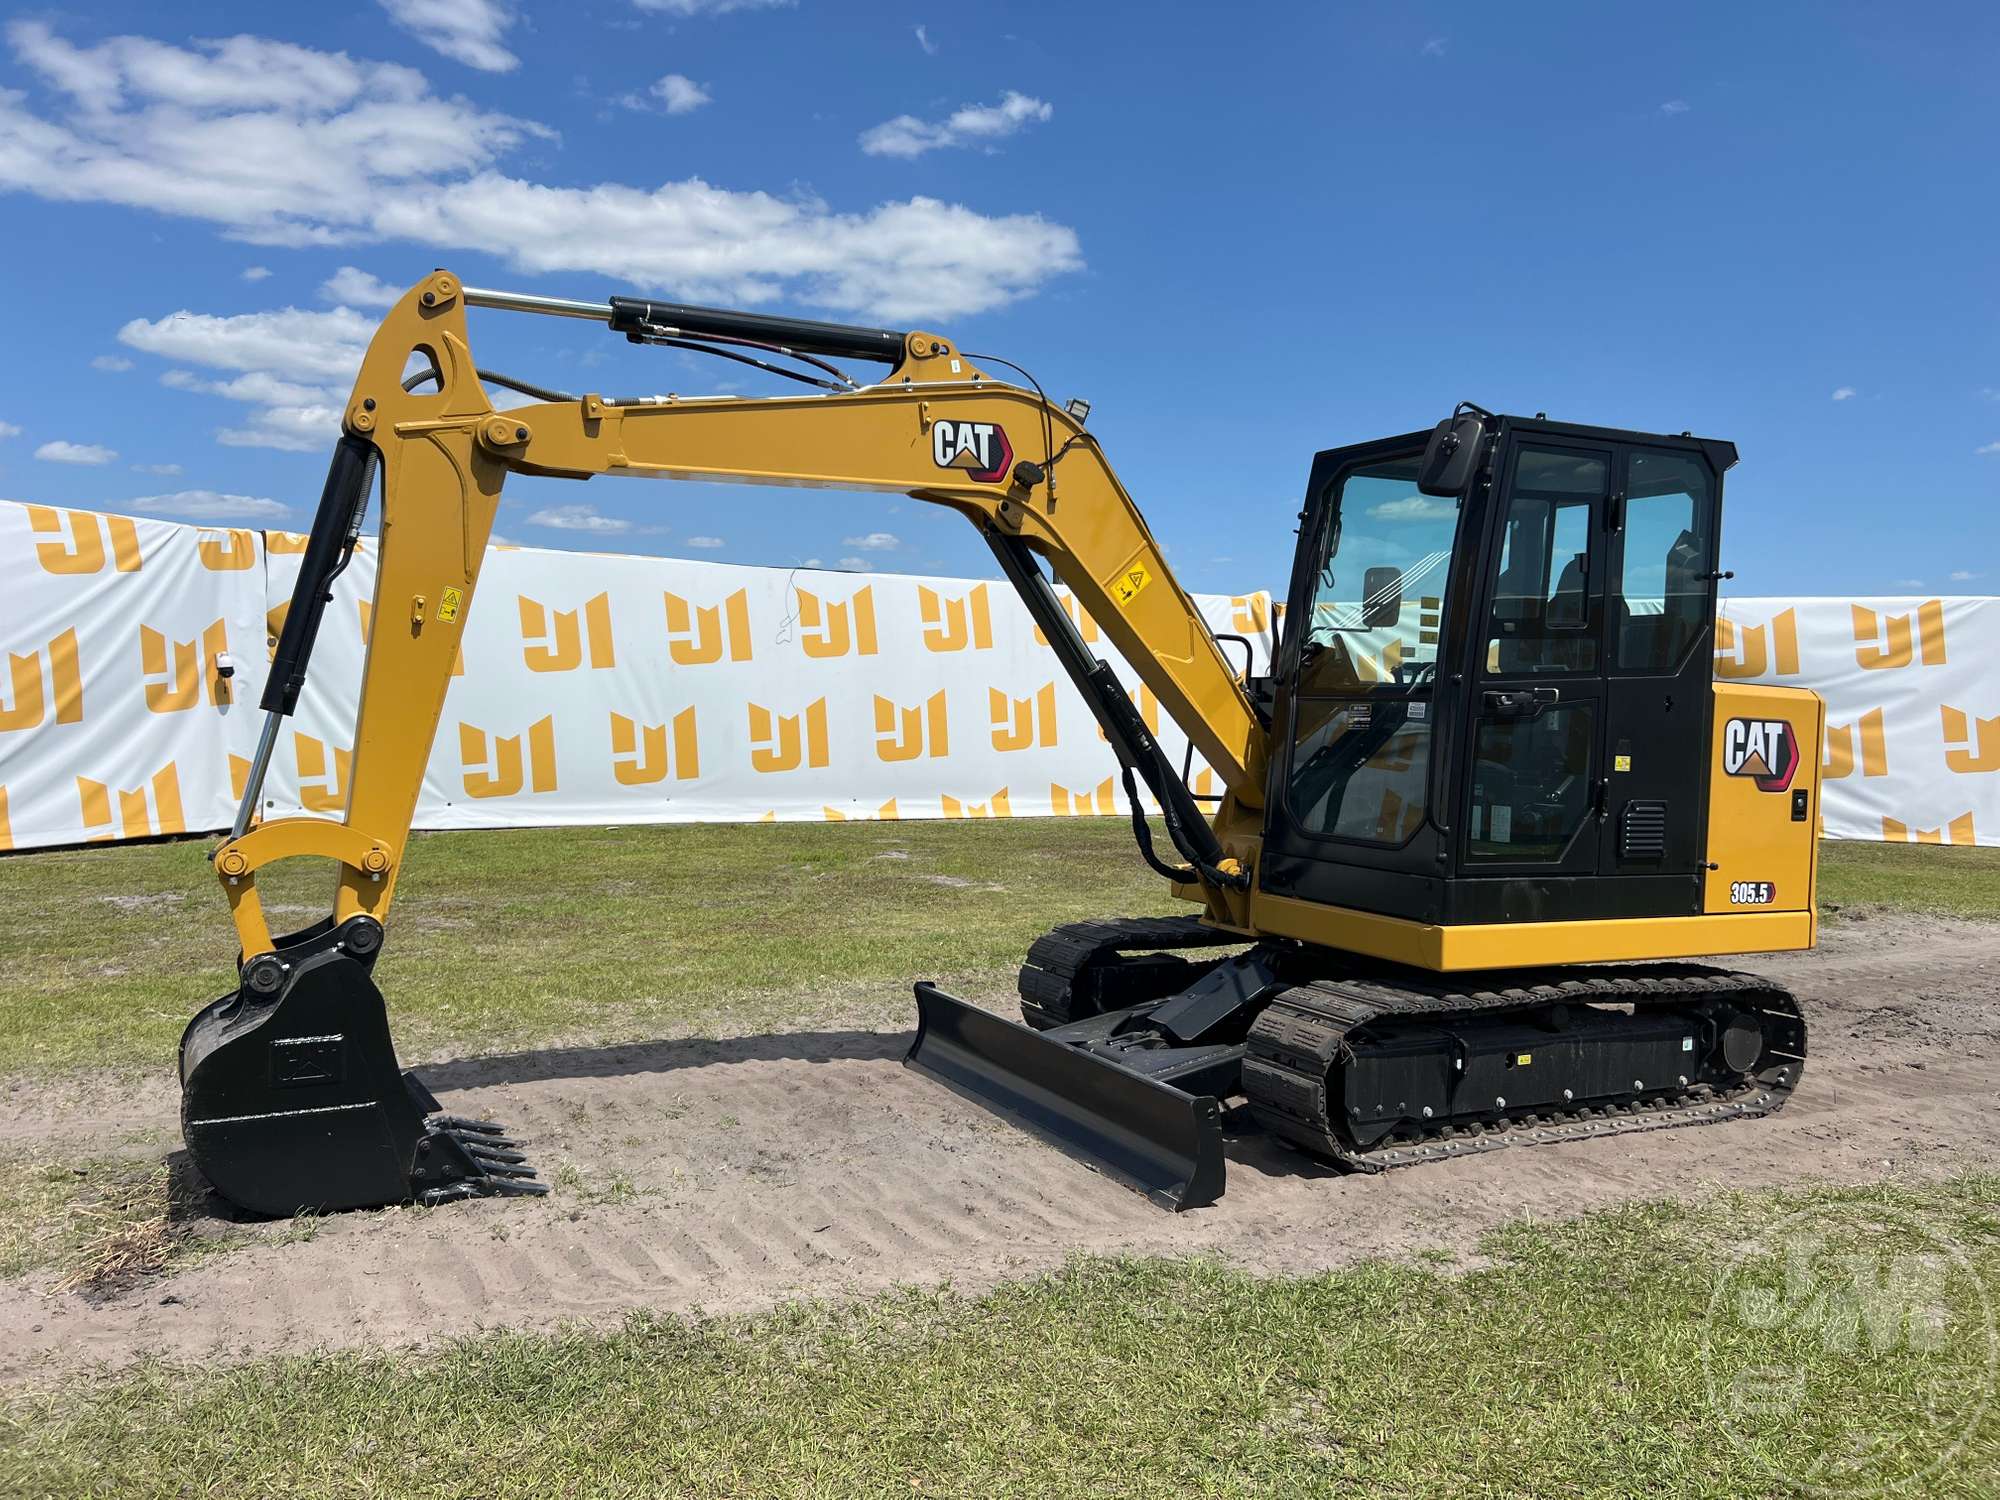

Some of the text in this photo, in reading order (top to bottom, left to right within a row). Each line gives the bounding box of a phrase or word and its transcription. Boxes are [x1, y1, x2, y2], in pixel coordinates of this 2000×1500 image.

[934, 421, 993, 469] CAT
[1725, 719, 1783, 775] CAT
[1731, 882, 1769, 904] 305.5
